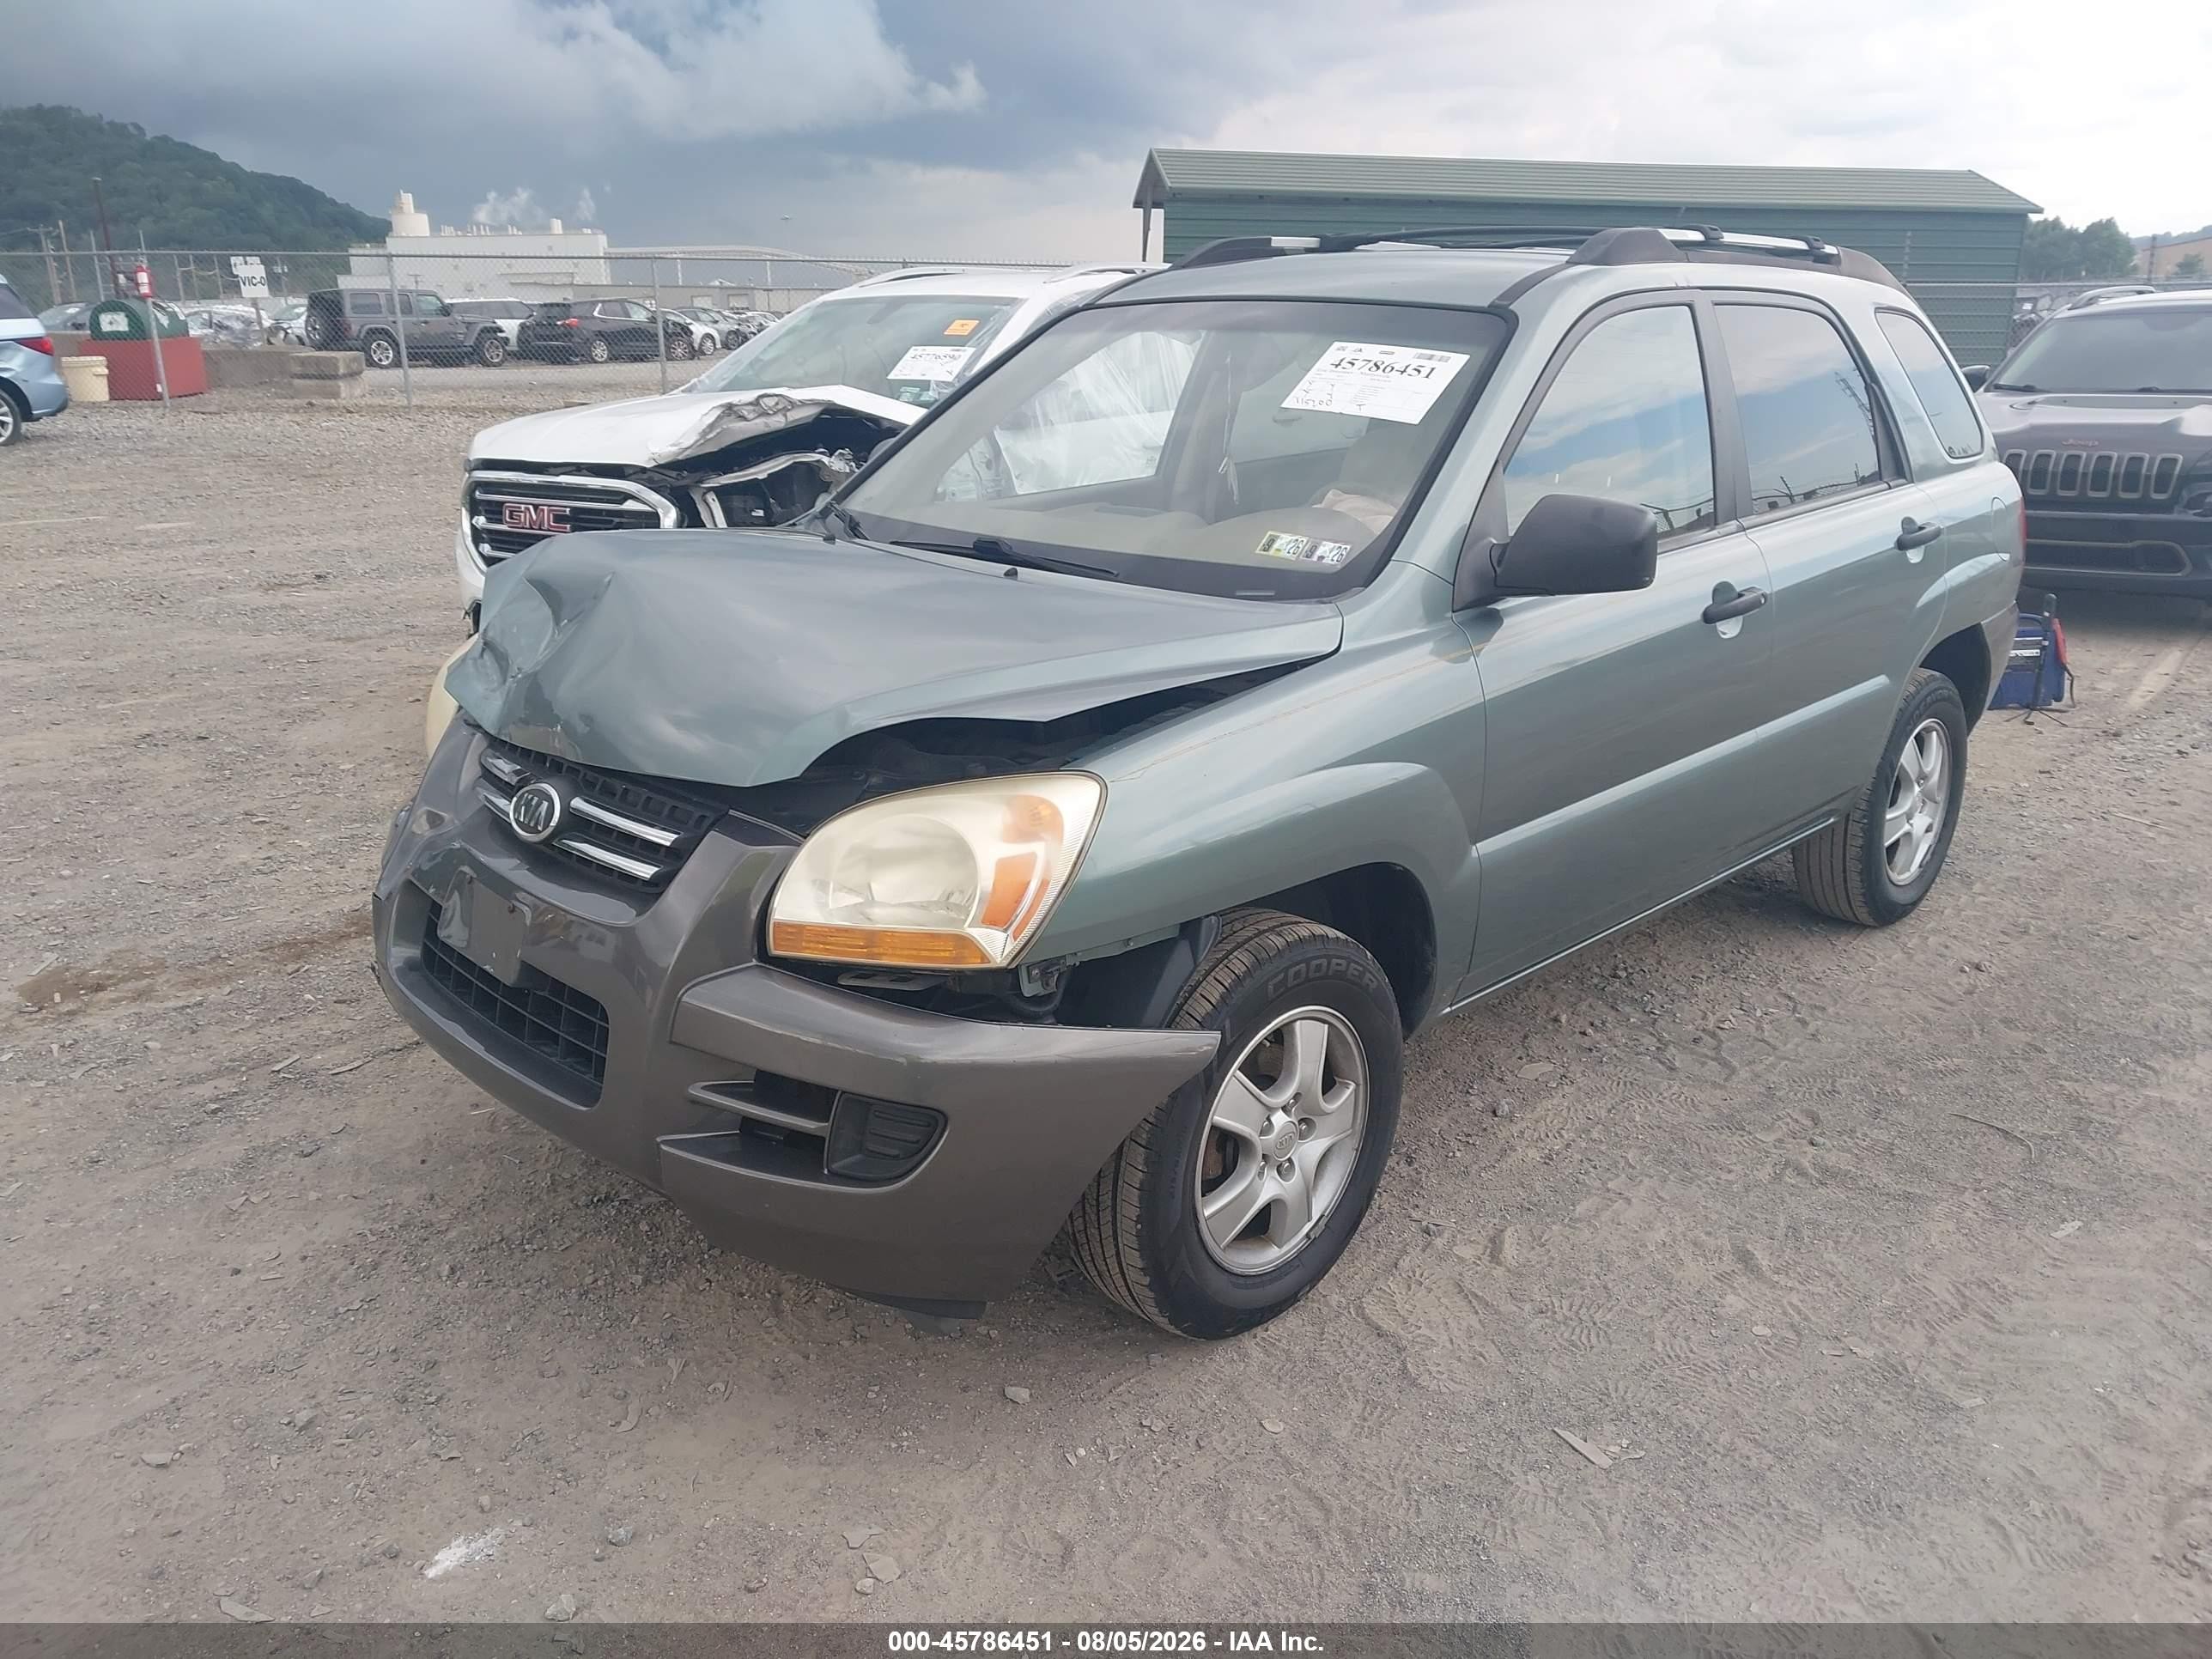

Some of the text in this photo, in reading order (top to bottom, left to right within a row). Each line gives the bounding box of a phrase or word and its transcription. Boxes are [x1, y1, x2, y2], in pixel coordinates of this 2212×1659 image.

[1330, 356, 1437, 380] 45786451
[502, 502, 571, 532] GMC
[1267, 958, 1380, 1001] COOPER
